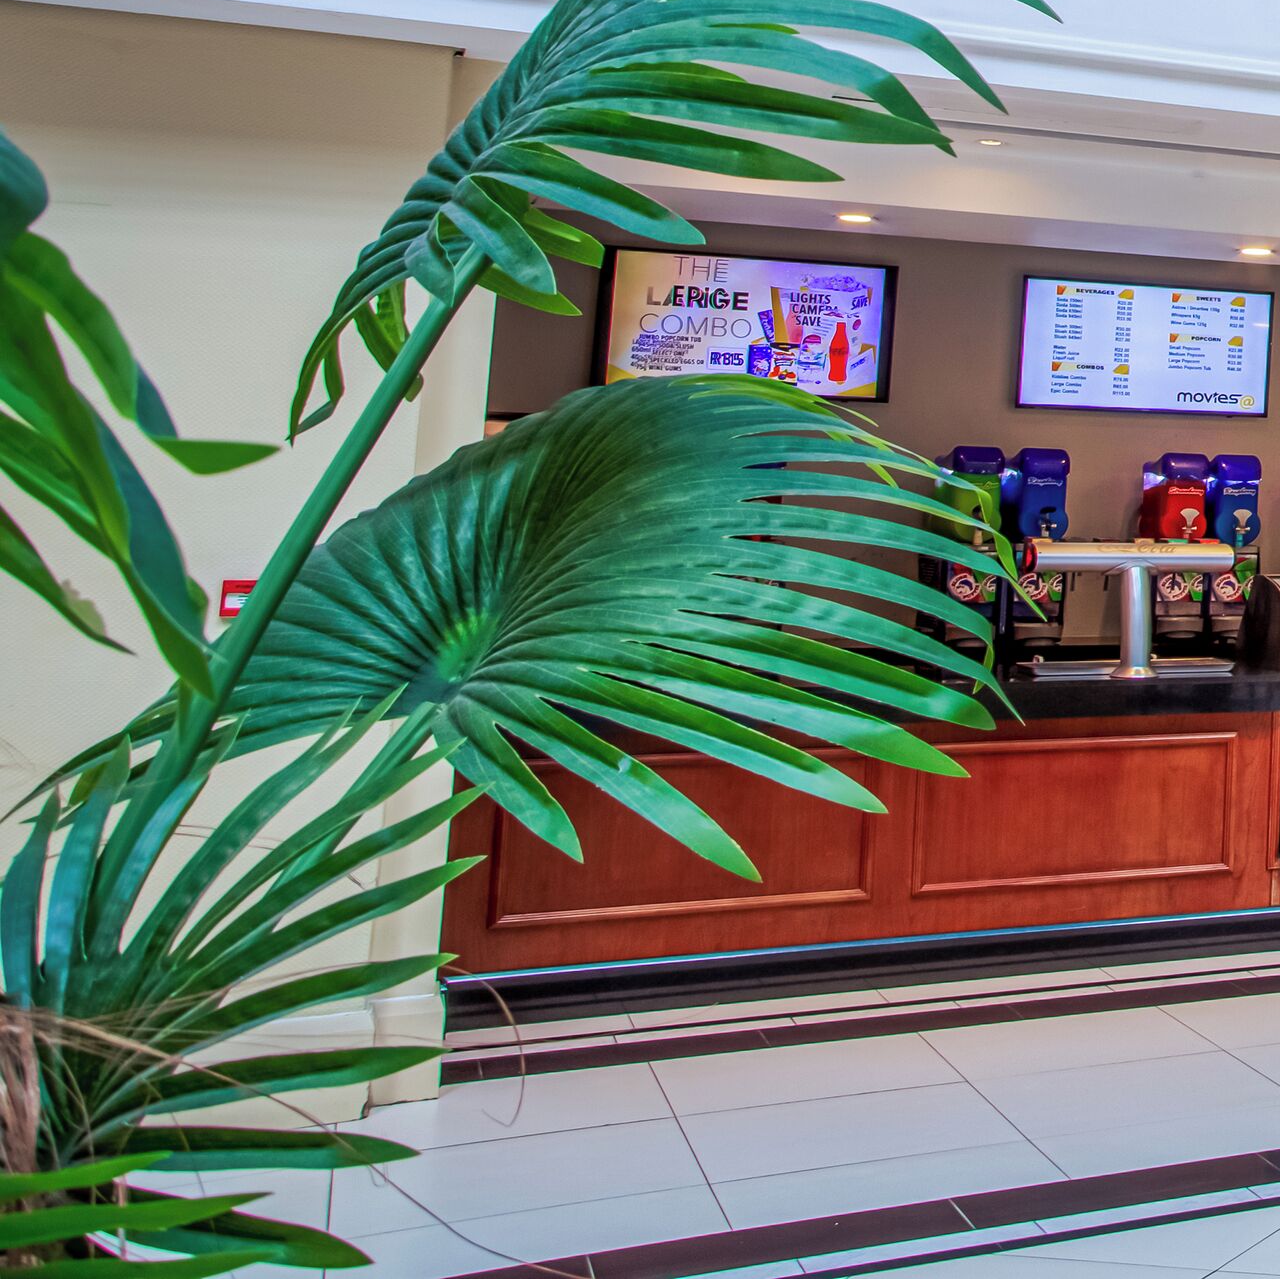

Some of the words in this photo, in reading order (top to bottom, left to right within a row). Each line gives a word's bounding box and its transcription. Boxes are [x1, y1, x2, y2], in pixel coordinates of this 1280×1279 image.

[673, 256, 729, 282] THE
[790, 292, 831, 305] LIGHTS
[1076, 288, 1115, 296] BEVERAGES
[640, 313, 752, 339] COMBO
[1176, 392, 1255, 409] movies@
